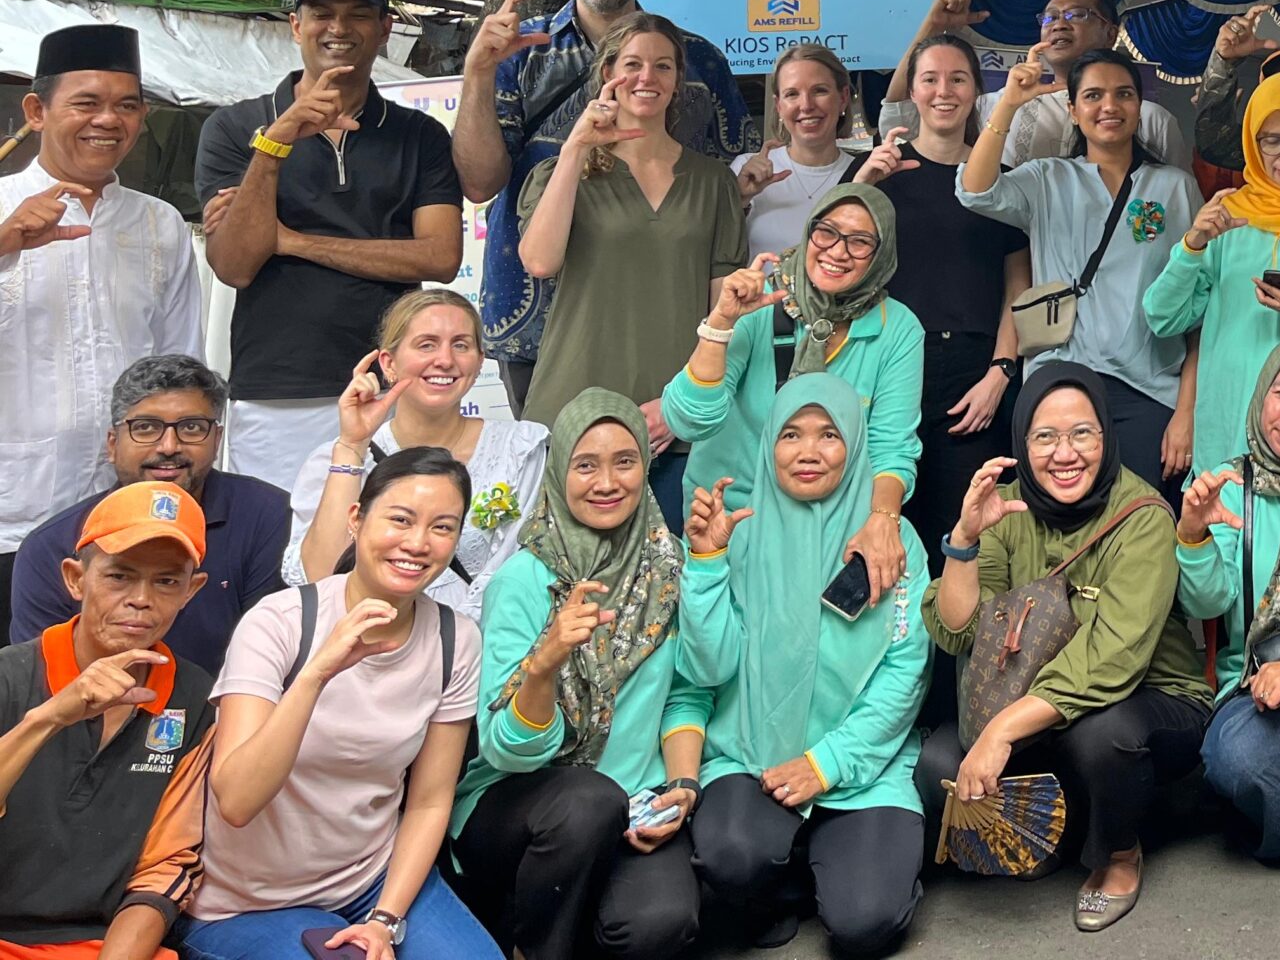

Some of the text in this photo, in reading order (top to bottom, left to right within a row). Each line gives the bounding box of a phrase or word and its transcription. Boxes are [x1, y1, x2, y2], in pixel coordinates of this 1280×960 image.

[753, 17, 815, 26] AMS REFILL
[725, 37, 769, 53] KIOS
[729, 56, 861, 68] ucing Envi pact
[460, 401, 479, 416] ah
[147, 753, 175, 765] PPSU
